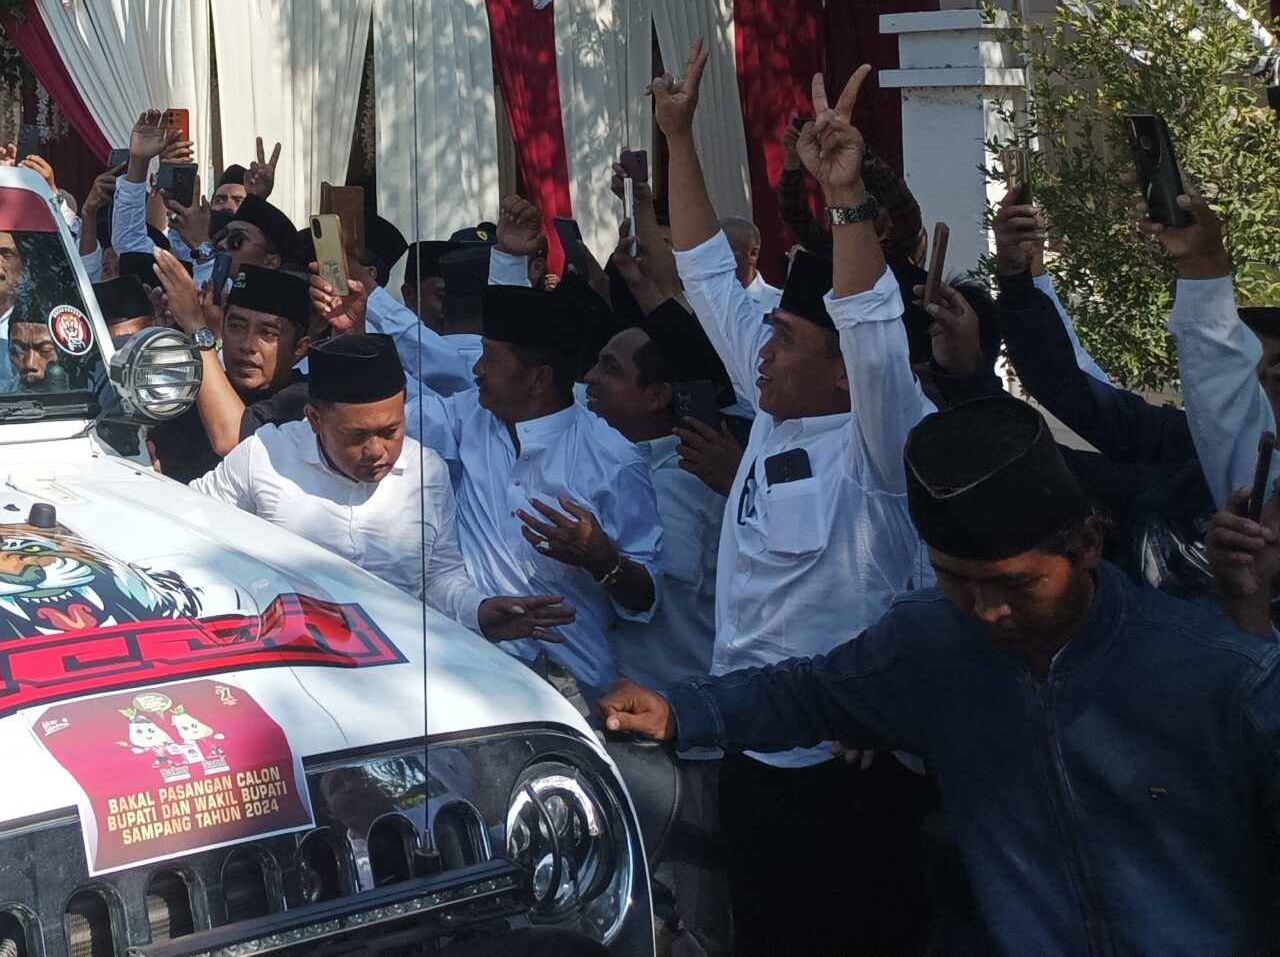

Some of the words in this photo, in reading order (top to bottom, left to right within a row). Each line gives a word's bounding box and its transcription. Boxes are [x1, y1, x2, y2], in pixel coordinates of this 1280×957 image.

[107, 808, 157, 832] BUPATI
[162, 799, 191, 819] DAN
[195, 790, 238, 812] WAKIL
[242, 782, 288, 803] BUPATI
[108, 792, 155, 815] BAKAL
[158, 775, 233, 802] PASANGAN
[236, 766, 281, 789] CALON
[122, 816, 192, 845] SAMPANG
[195, 807, 241, 828] TAHUN
[245, 798, 280, 819] 2024
